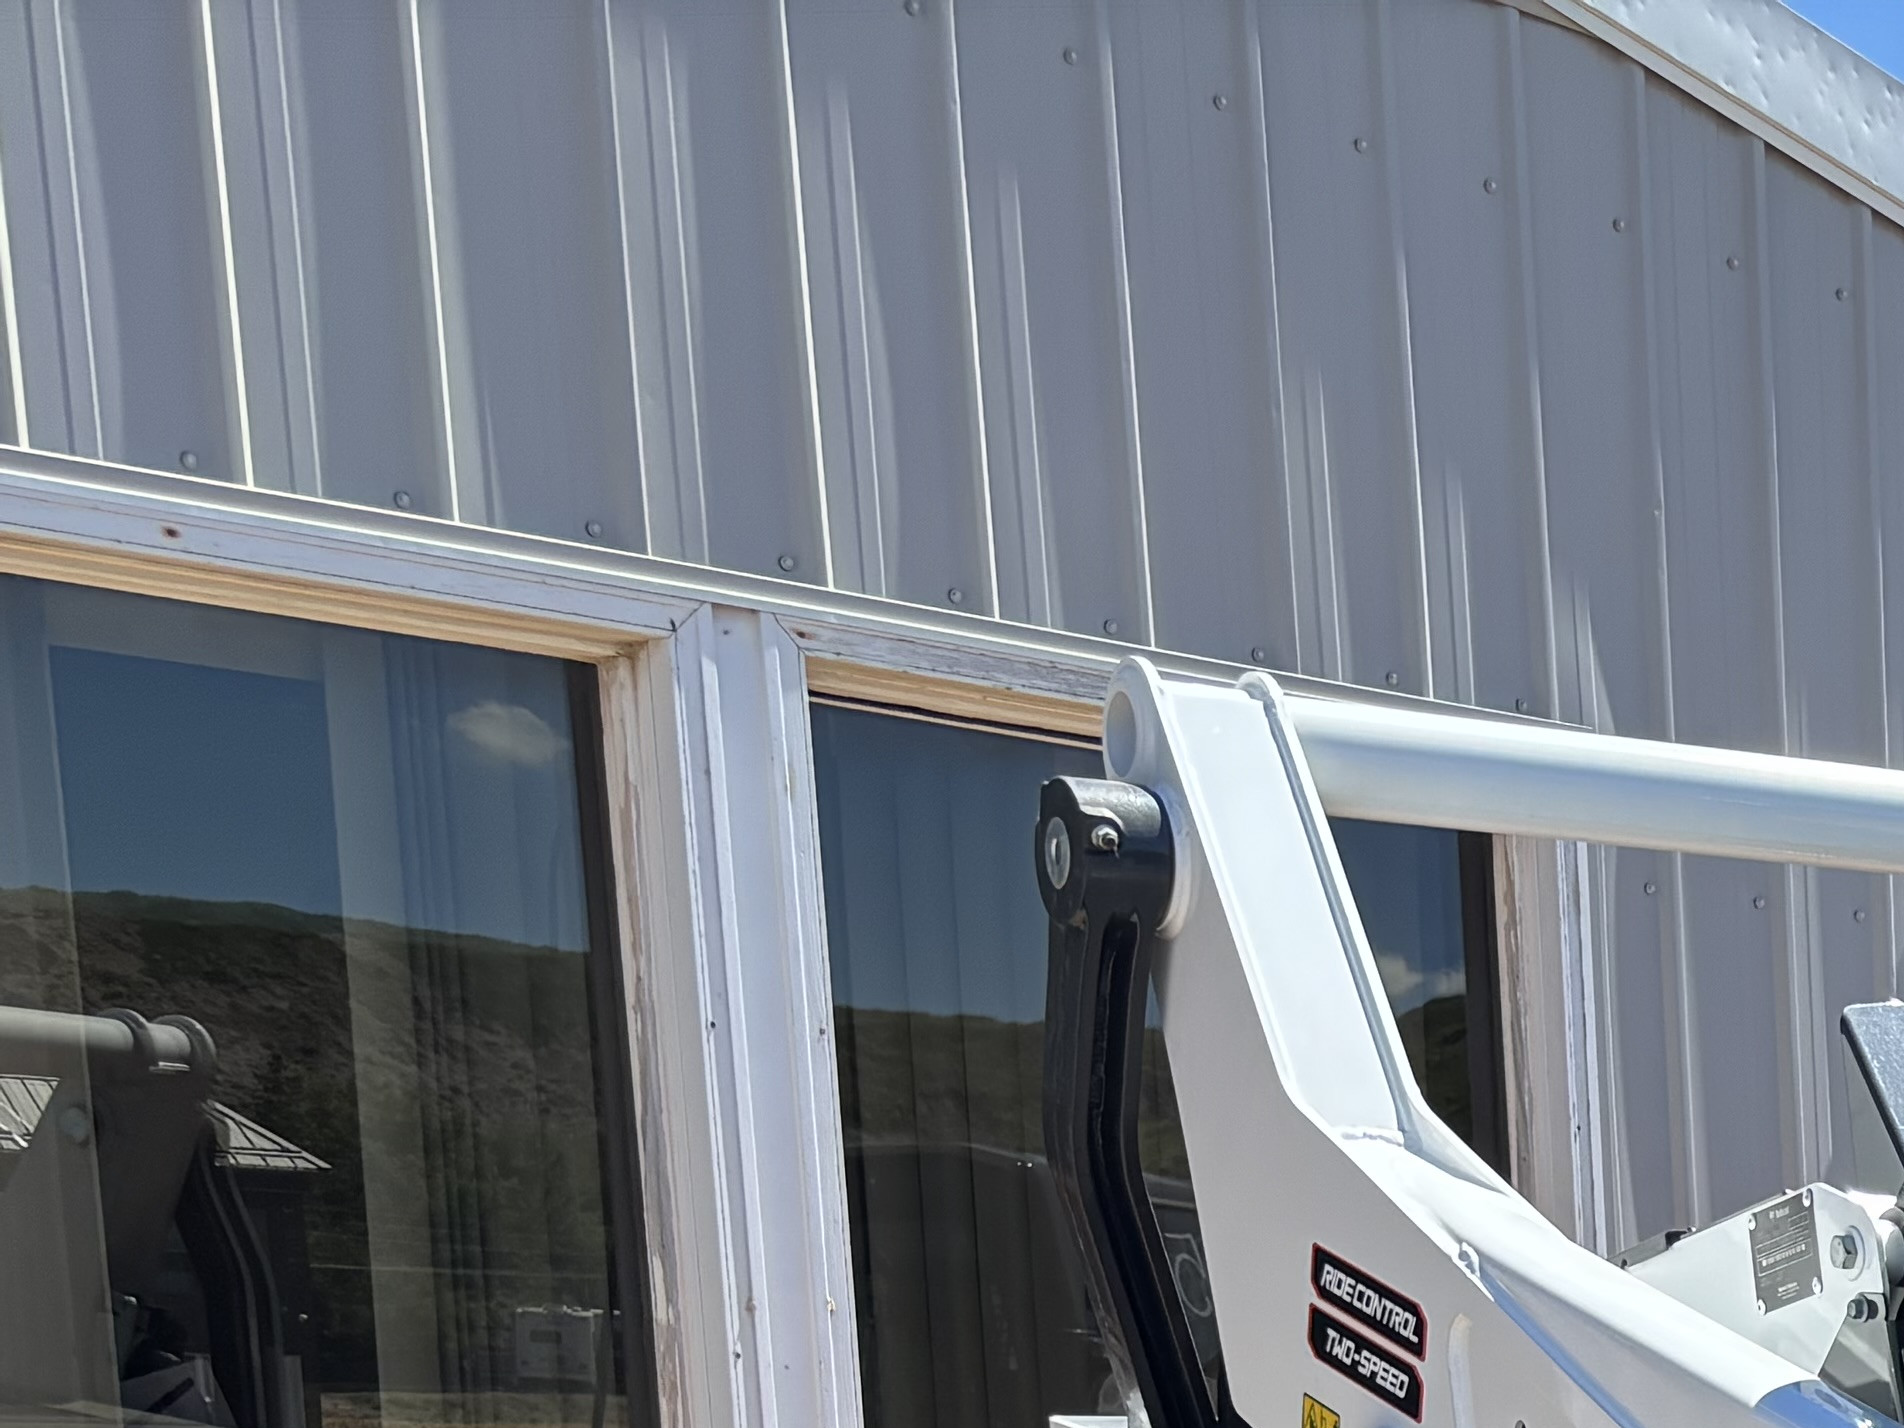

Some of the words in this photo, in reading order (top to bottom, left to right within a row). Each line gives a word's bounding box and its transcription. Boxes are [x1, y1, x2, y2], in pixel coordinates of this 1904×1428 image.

[1321, 1263, 1356, 1303] RIDE
[1352, 1282, 1419, 1344] CONTROL
[1326, 1326, 1409, 1399] TWO-SPEED
